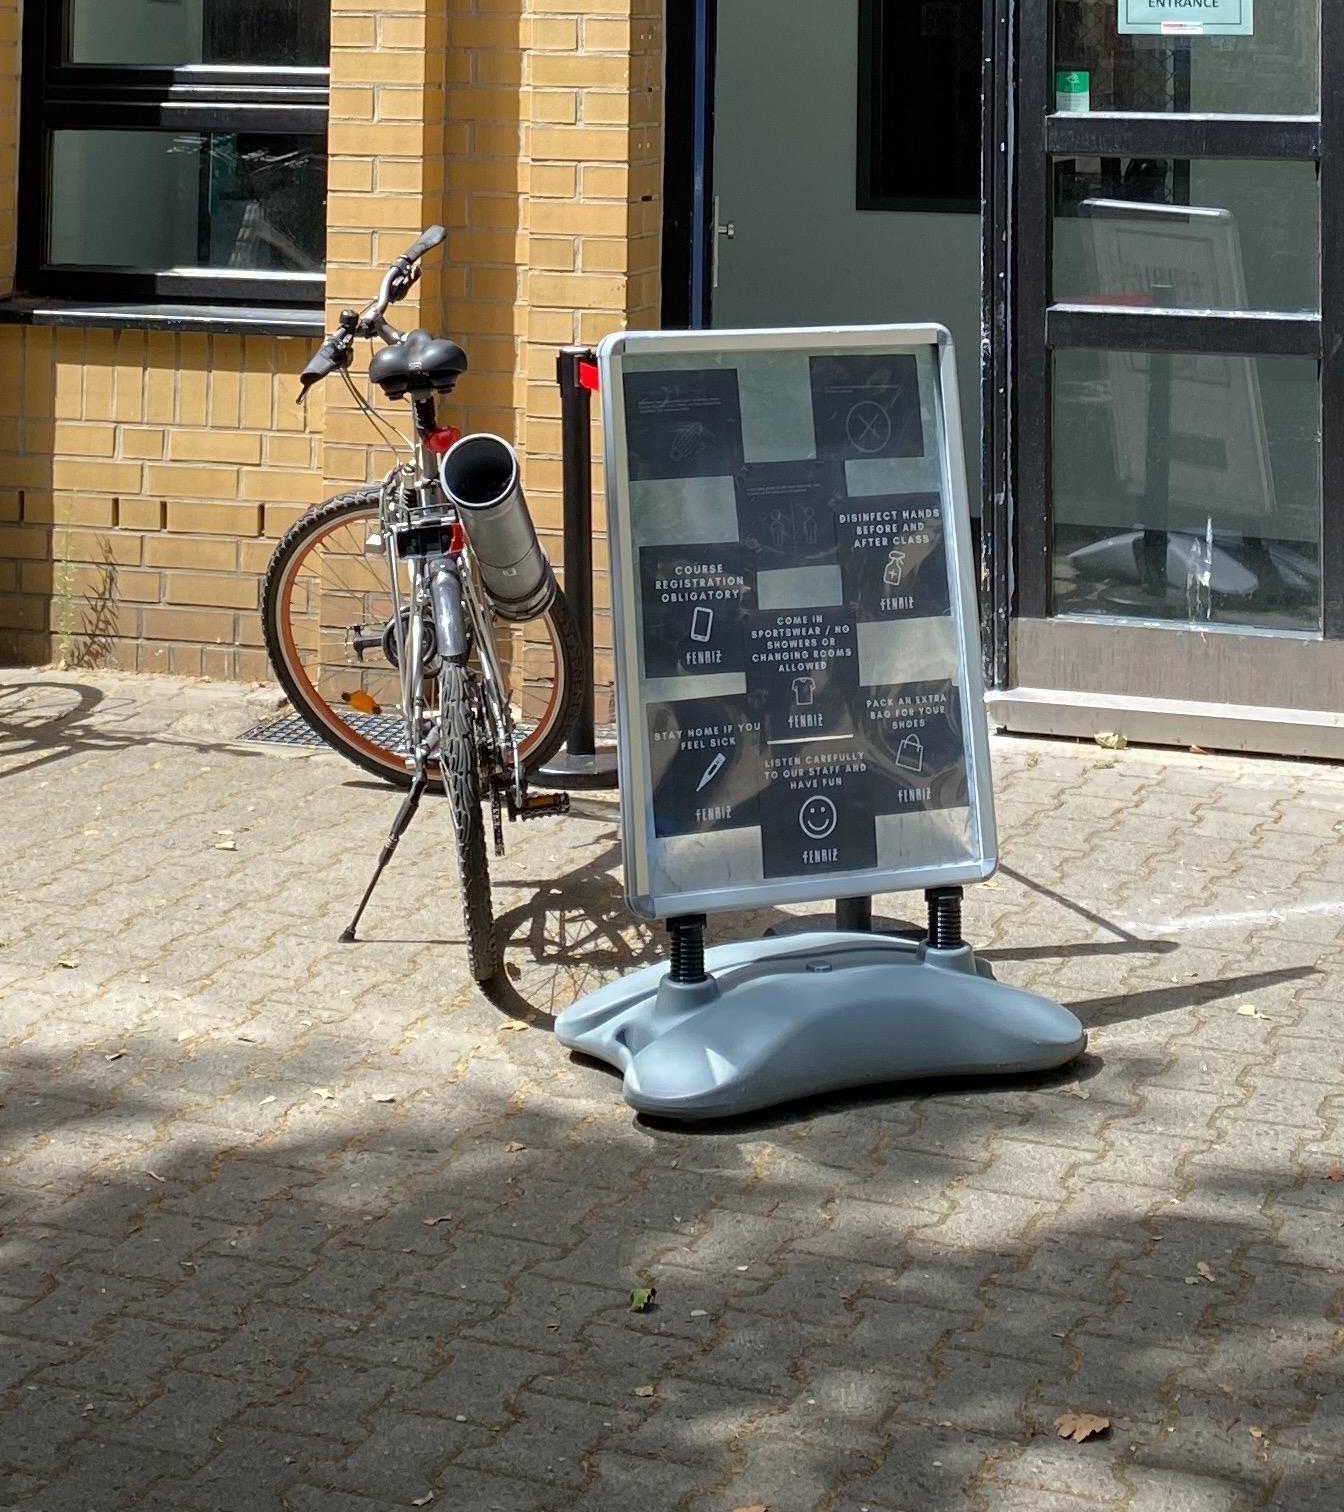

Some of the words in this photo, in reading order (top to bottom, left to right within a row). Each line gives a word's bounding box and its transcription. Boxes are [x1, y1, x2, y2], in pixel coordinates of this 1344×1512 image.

[839, 511, 897, 523] DISINFECT
[902, 508, 940, 519] HANDS
[856, 524, 897, 535] BEFORE
[903, 522, 924, 531] AND
[854, 537, 888, 548] AFTER
[892, 534, 929, 545] CLASS
[674, 563, 723, 575] COURSE
[655, 575, 744, 589] REGISTRATION
[661, 589, 739, 603] OBLIGATORY
[777, 615, 808, 625] COME
[812, 614, 823, 623] IN
[751, 626, 821, 639] SPORTSWEAR
[834, 624, 850, 634] NO
[766, 638, 817, 649] SHOWERS
[821, 637, 836, 646] OR
[752, 650, 809, 662] CHANGING
[813, 648, 852, 658] ROOMS
[778, 661, 827, 673] ALLOWED
[866, 698, 894, 708] PACK
[898, 696, 912, 706] AN
[915, 694, 947, 705] EXTRA
[870, 710, 891, 720] BAG
[895, 708, 914, 718] FOR
[918, 705, 945, 715] YOUR
[892, 718, 925, 729] SHOES
[654, 730, 682, 741] STAY
[687, 726, 719, 737] HOME
[723, 724, 733, 734] IF
[738, 722, 761, 733] YOU
[681, 740, 705, 750] FEEL
[710, 737, 736, 748] SICK
[764, 756, 801, 768] LISTEN
[805, 751, 865, 764] CAREFULLY
[764, 770, 778, 780] TO
[783, 768, 804, 778] OUR
[809, 764, 840, 776] STAFF
[845, 763, 867, 773] AND
[790, 778, 818, 790] HAVE
[822, 776, 843, 787] FUN
